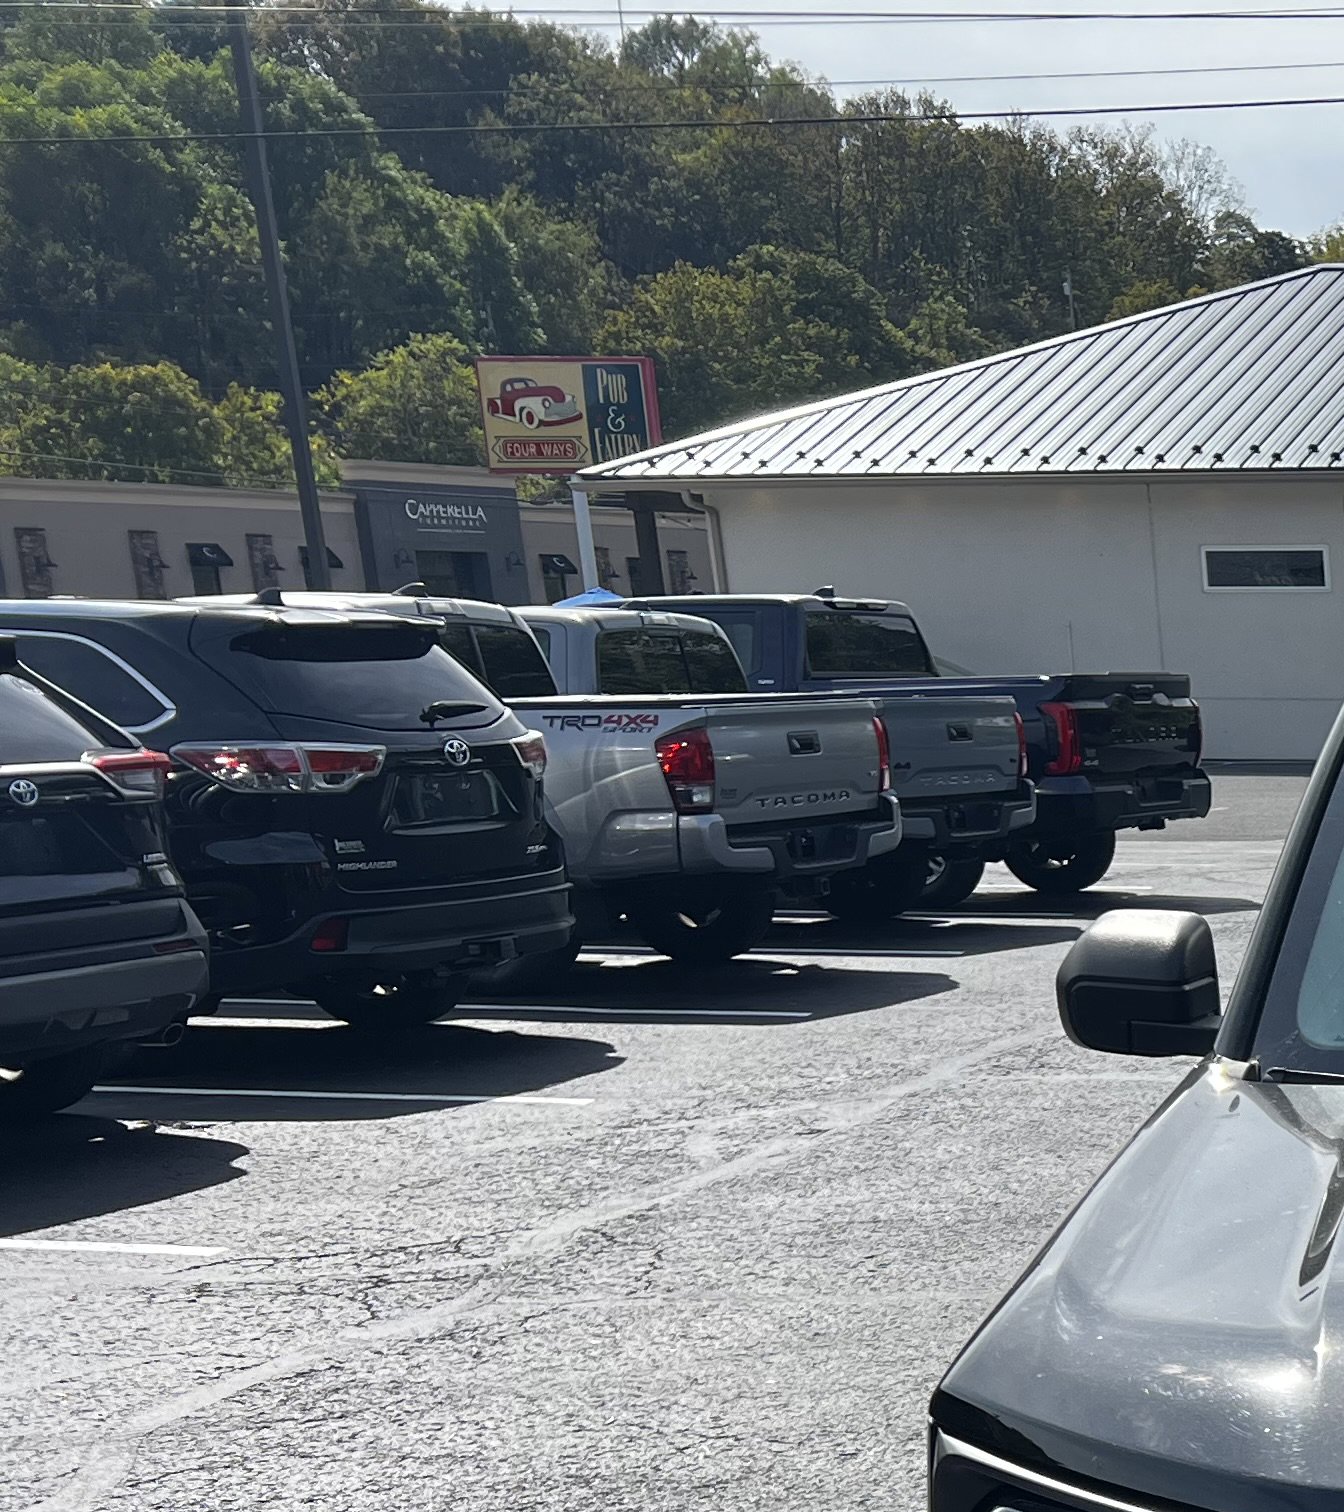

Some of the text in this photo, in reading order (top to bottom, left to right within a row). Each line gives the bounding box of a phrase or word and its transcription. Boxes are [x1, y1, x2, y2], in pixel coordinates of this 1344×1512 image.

[596, 367, 628, 404] PUB
[607, 405, 625, 432] &
[506, 443, 574, 457] FOUR WAYS
[405, 499, 488, 523] CAPPERELLA
[542, 715, 602, 732] TRD
[755, 790, 851, 809] TACOMA
